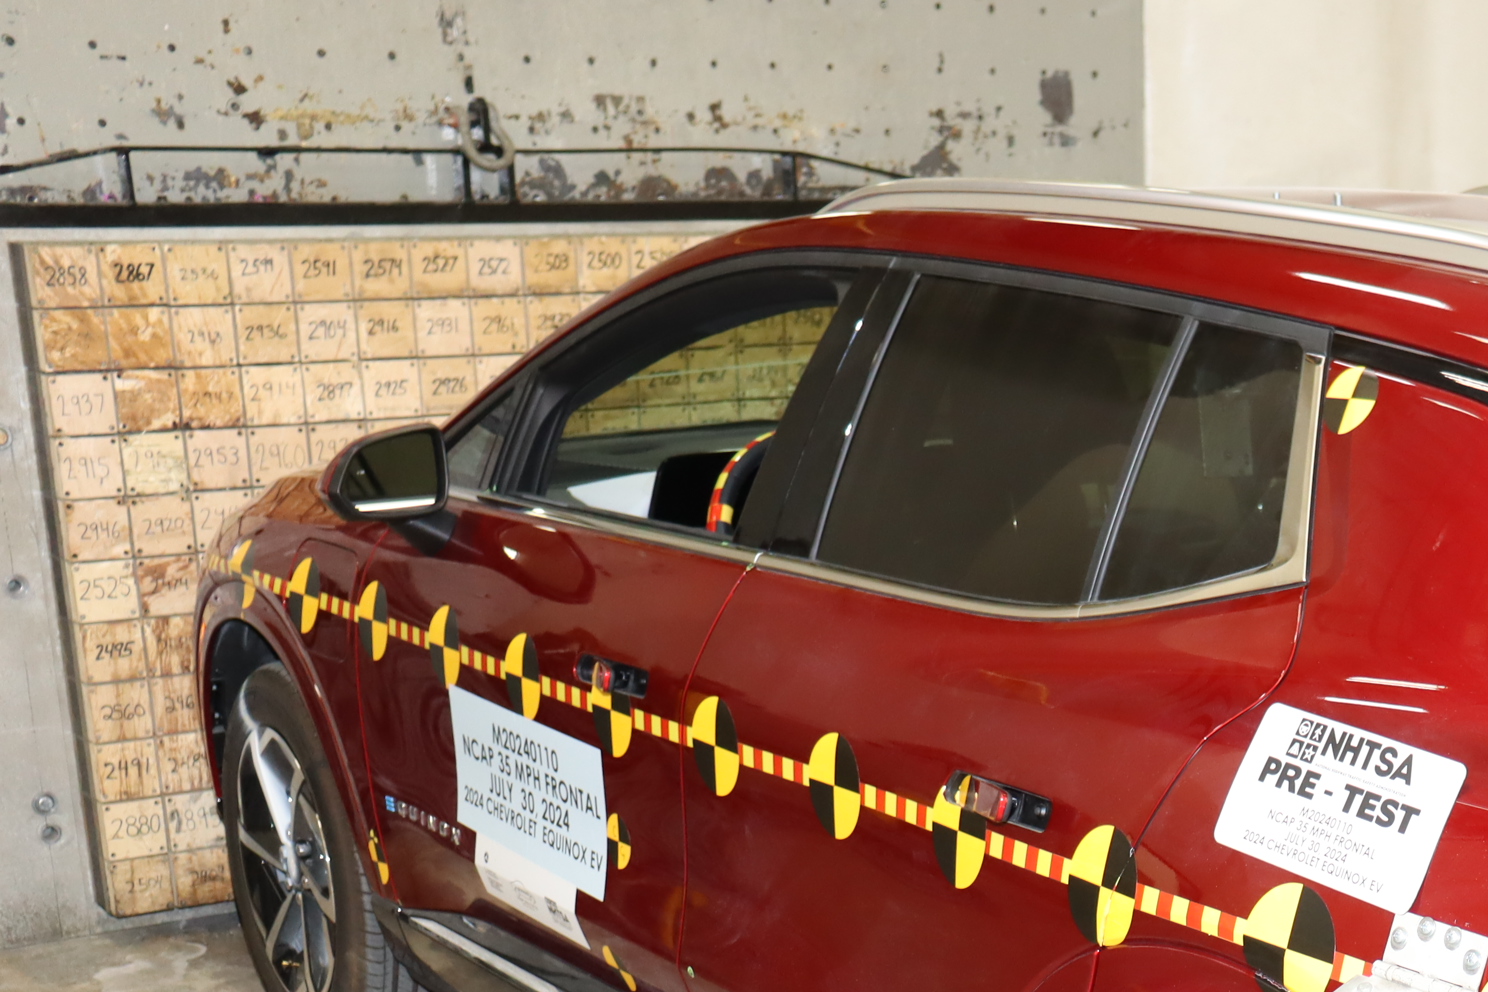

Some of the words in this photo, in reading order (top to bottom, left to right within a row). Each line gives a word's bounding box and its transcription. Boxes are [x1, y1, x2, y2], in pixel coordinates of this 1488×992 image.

[301, 258, 337, 279] 2591
[363, 257, 403, 279] 2574
[587, 250, 622, 270] 2500
[44, 265, 87, 287] 2858
[114, 262, 155, 284] 2867
[246, 323, 287, 341] 2936
[308, 318, 347, 340] 2904
[367, 318, 399, 336] 2916
[426, 317, 459, 336] 2931
[250, 380, 296, 402] 2914
[375, 379, 408, 398] 2925
[57, 393, 105, 416] 2937
[193, 446, 239, 468] 2953
[255, 443, 306, 471] 2960
[77, 520, 121, 542] 2946
[142, 517, 185, 536] 2920
[79, 575, 132, 601] 2525
[95, 641, 135, 662] 2495
[100, 703, 147, 721] 2560
[492, 723, 559, 773] M20240110
[1320, 727, 1413, 786] NHTSA
[104, 757, 150, 780] 2491
[462, 734, 494, 767] NCAP
[498, 751, 512, 776] 35
[515, 760, 541, 791] MPH
[545, 774, 602, 820] FRONTAL
[489, 773, 514, 801] JULY
[521, 788, 539, 818] 30,
[542, 798, 570, 832] 2024
[1258, 756, 1321, 800] PRE
[1342, 783, 1421, 834] TEST
[111, 812, 161, 840] 2880
[385, 795, 462, 846] EQUINOX
[464, 785, 485, 811] 2024
[486, 797, 538, 839] CHEVROLET
[542, 828, 587, 867] EQUINOX
[590, 853, 604, 872] EV
[1299, 806, 1353, 835] M20240110
[1267, 808, 1295, 827] NCAP
[1296, 819, 1309, 833] 35
[1309, 824, 1332, 842] MPH
[1333, 833, 1375, 861] FRONTAL
[1284, 830, 1307, 848] JULY
[1323, 845, 1347, 864] 2024
[1243, 829, 1266, 847] 2024
[1267, 838, 1320, 868] CHEVROLET
[1321, 861, 1367, 888] EQUINOX
[1370, 879, 1384, 894] EV
